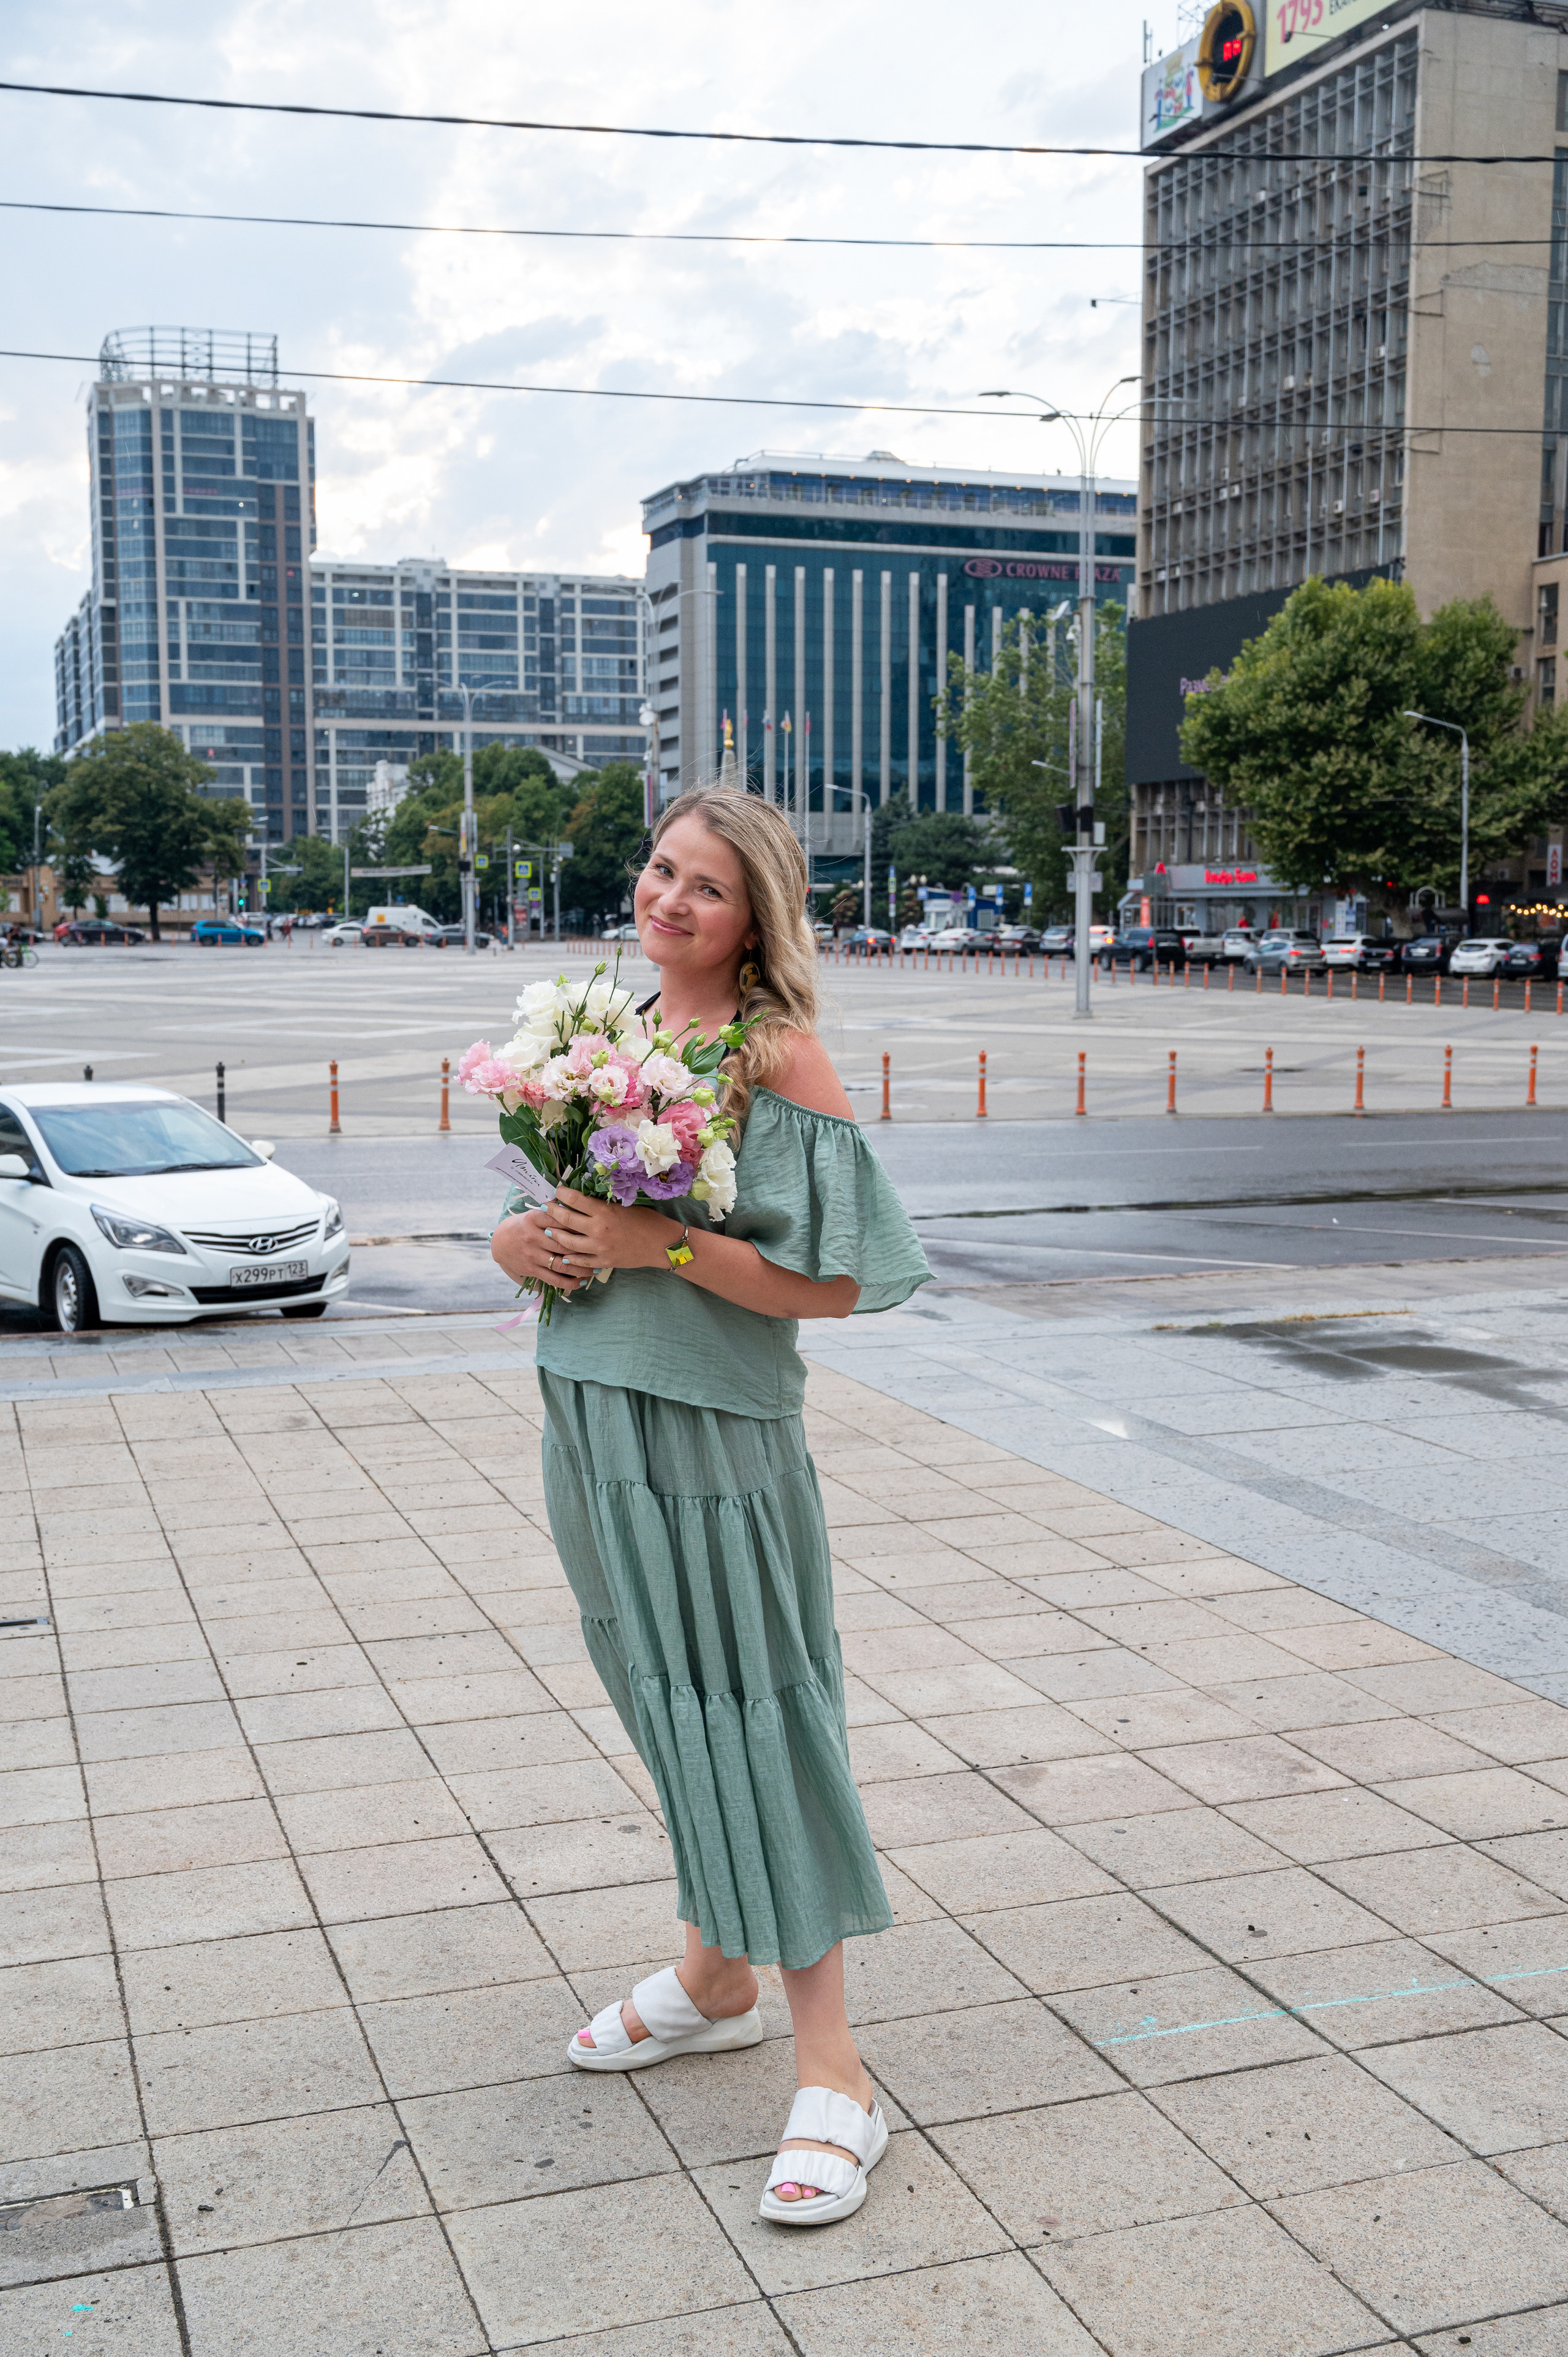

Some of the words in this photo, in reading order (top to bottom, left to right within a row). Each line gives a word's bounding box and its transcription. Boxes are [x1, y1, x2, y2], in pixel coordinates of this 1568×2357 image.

[1006, 562, 1069, 580] CROWNE
[1075, 567, 1120, 582] AZA
[287, 1263, 305, 1274] 123
